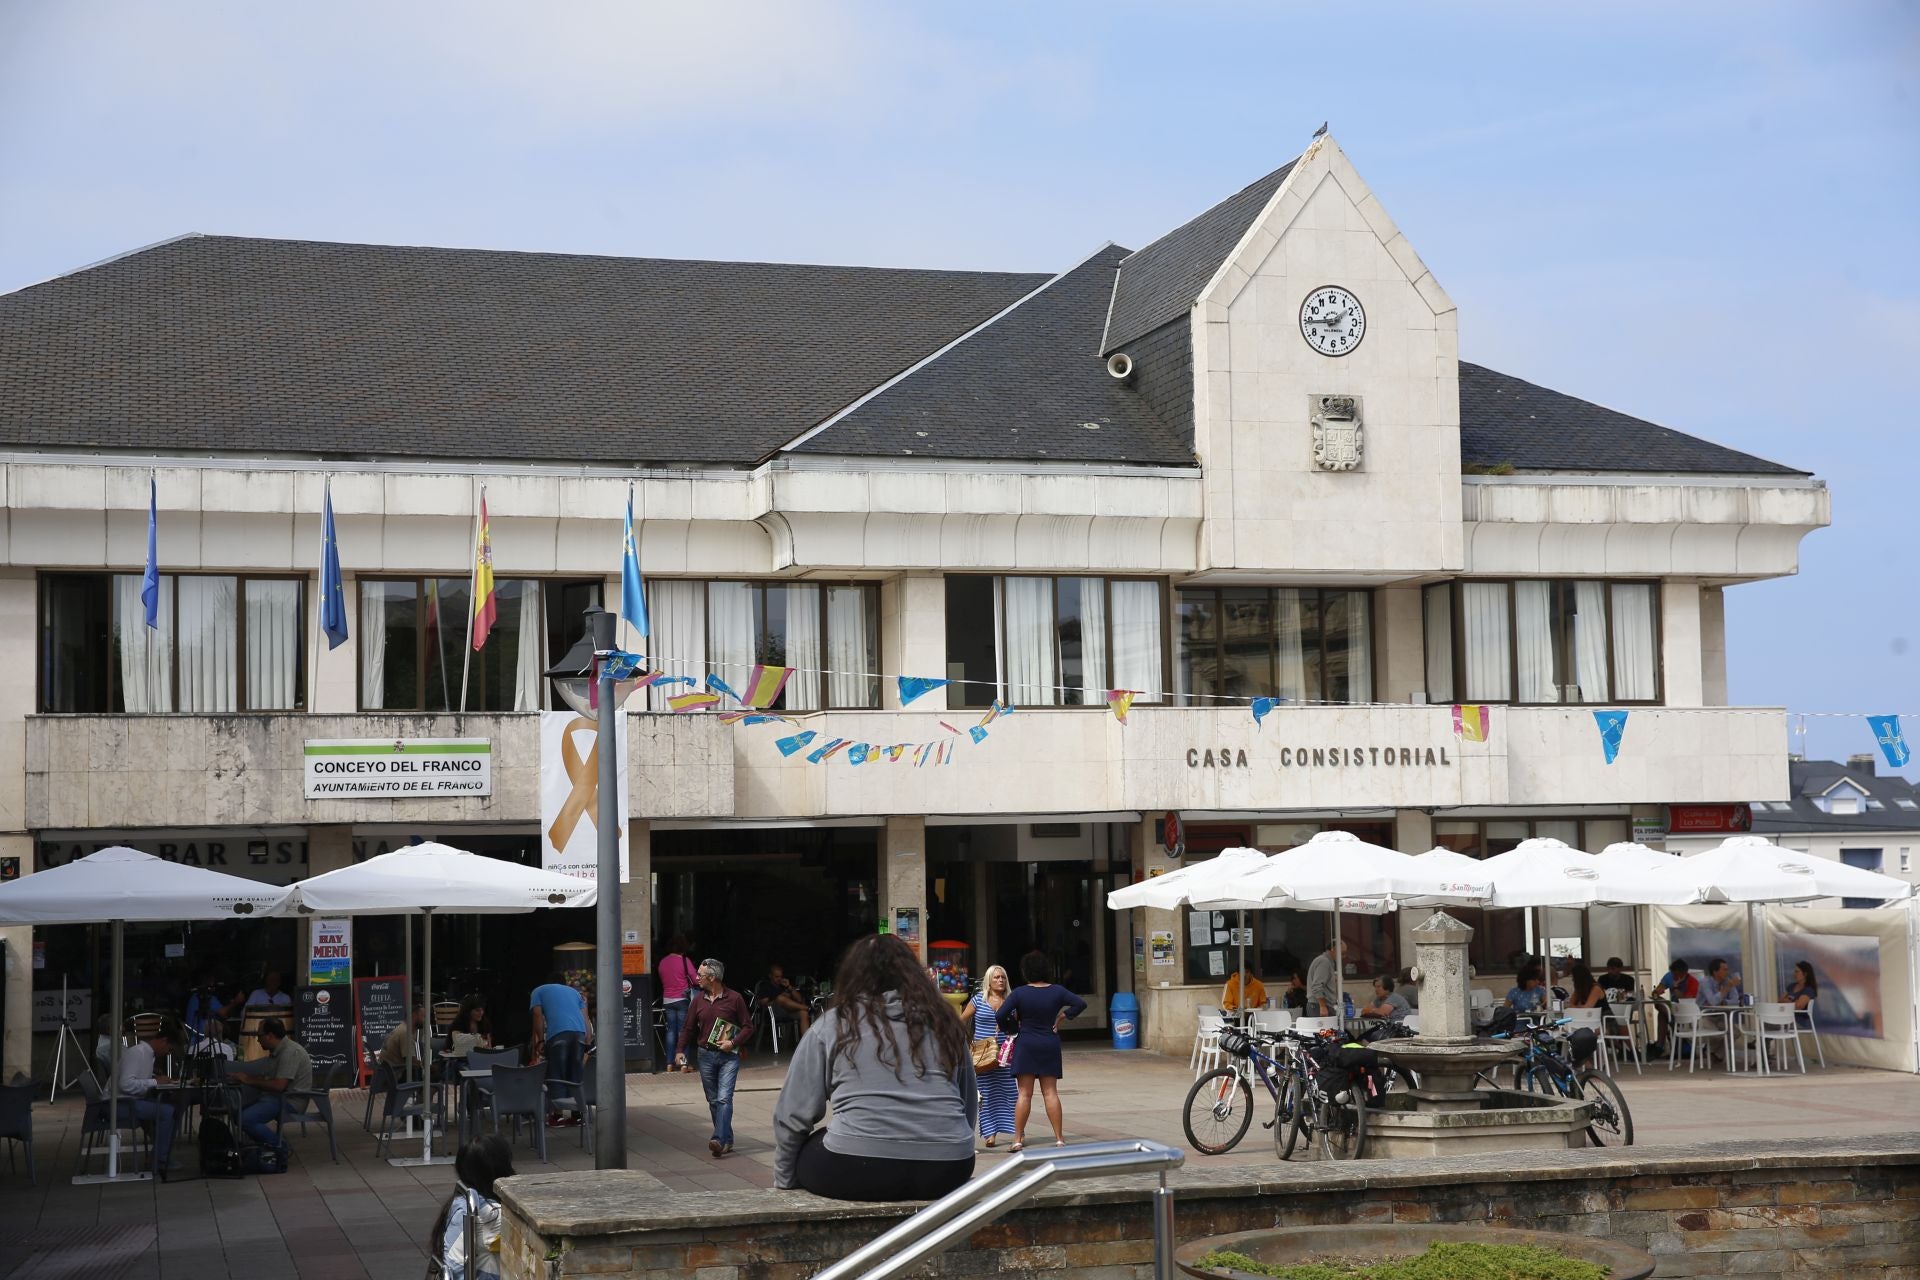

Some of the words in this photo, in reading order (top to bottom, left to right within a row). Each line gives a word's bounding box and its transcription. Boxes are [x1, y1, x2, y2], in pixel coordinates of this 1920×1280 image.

[1319, 298, 1325, 307] 11
[1328, 295, 1337, 304] 12
[1342, 299, 1346, 308] 1
[1310, 306, 1320, 315] 10
[1348, 307, 1354, 316] 2
[1351, 318, 1358, 327] 3
[1311, 327, 1317, 336] 8
[1348, 328, 1354, 337] 4
[1320, 335, 1326, 345] 7
[1330, 339, 1336, 348] 6
[1340, 336, 1347, 345] 5
[1186, 748, 1248, 768] CASA
[1280, 747, 1450, 767] CONSISTORIAL
[314, 761, 386, 774] CONCEYO
[390, 761, 418, 773] DEL
[422, 760, 482, 772] FRANCO
[313, 782, 400, 792] AYUNTAMIENTO
[403, 781, 418, 791] DE
[420, 781, 434, 791] EL
[437, 780, 483, 791] FRANCO
[159, 841, 228, 866] BAR
[319, 935, 343, 943] HAY
[313, 943, 349, 958] MENÚ
